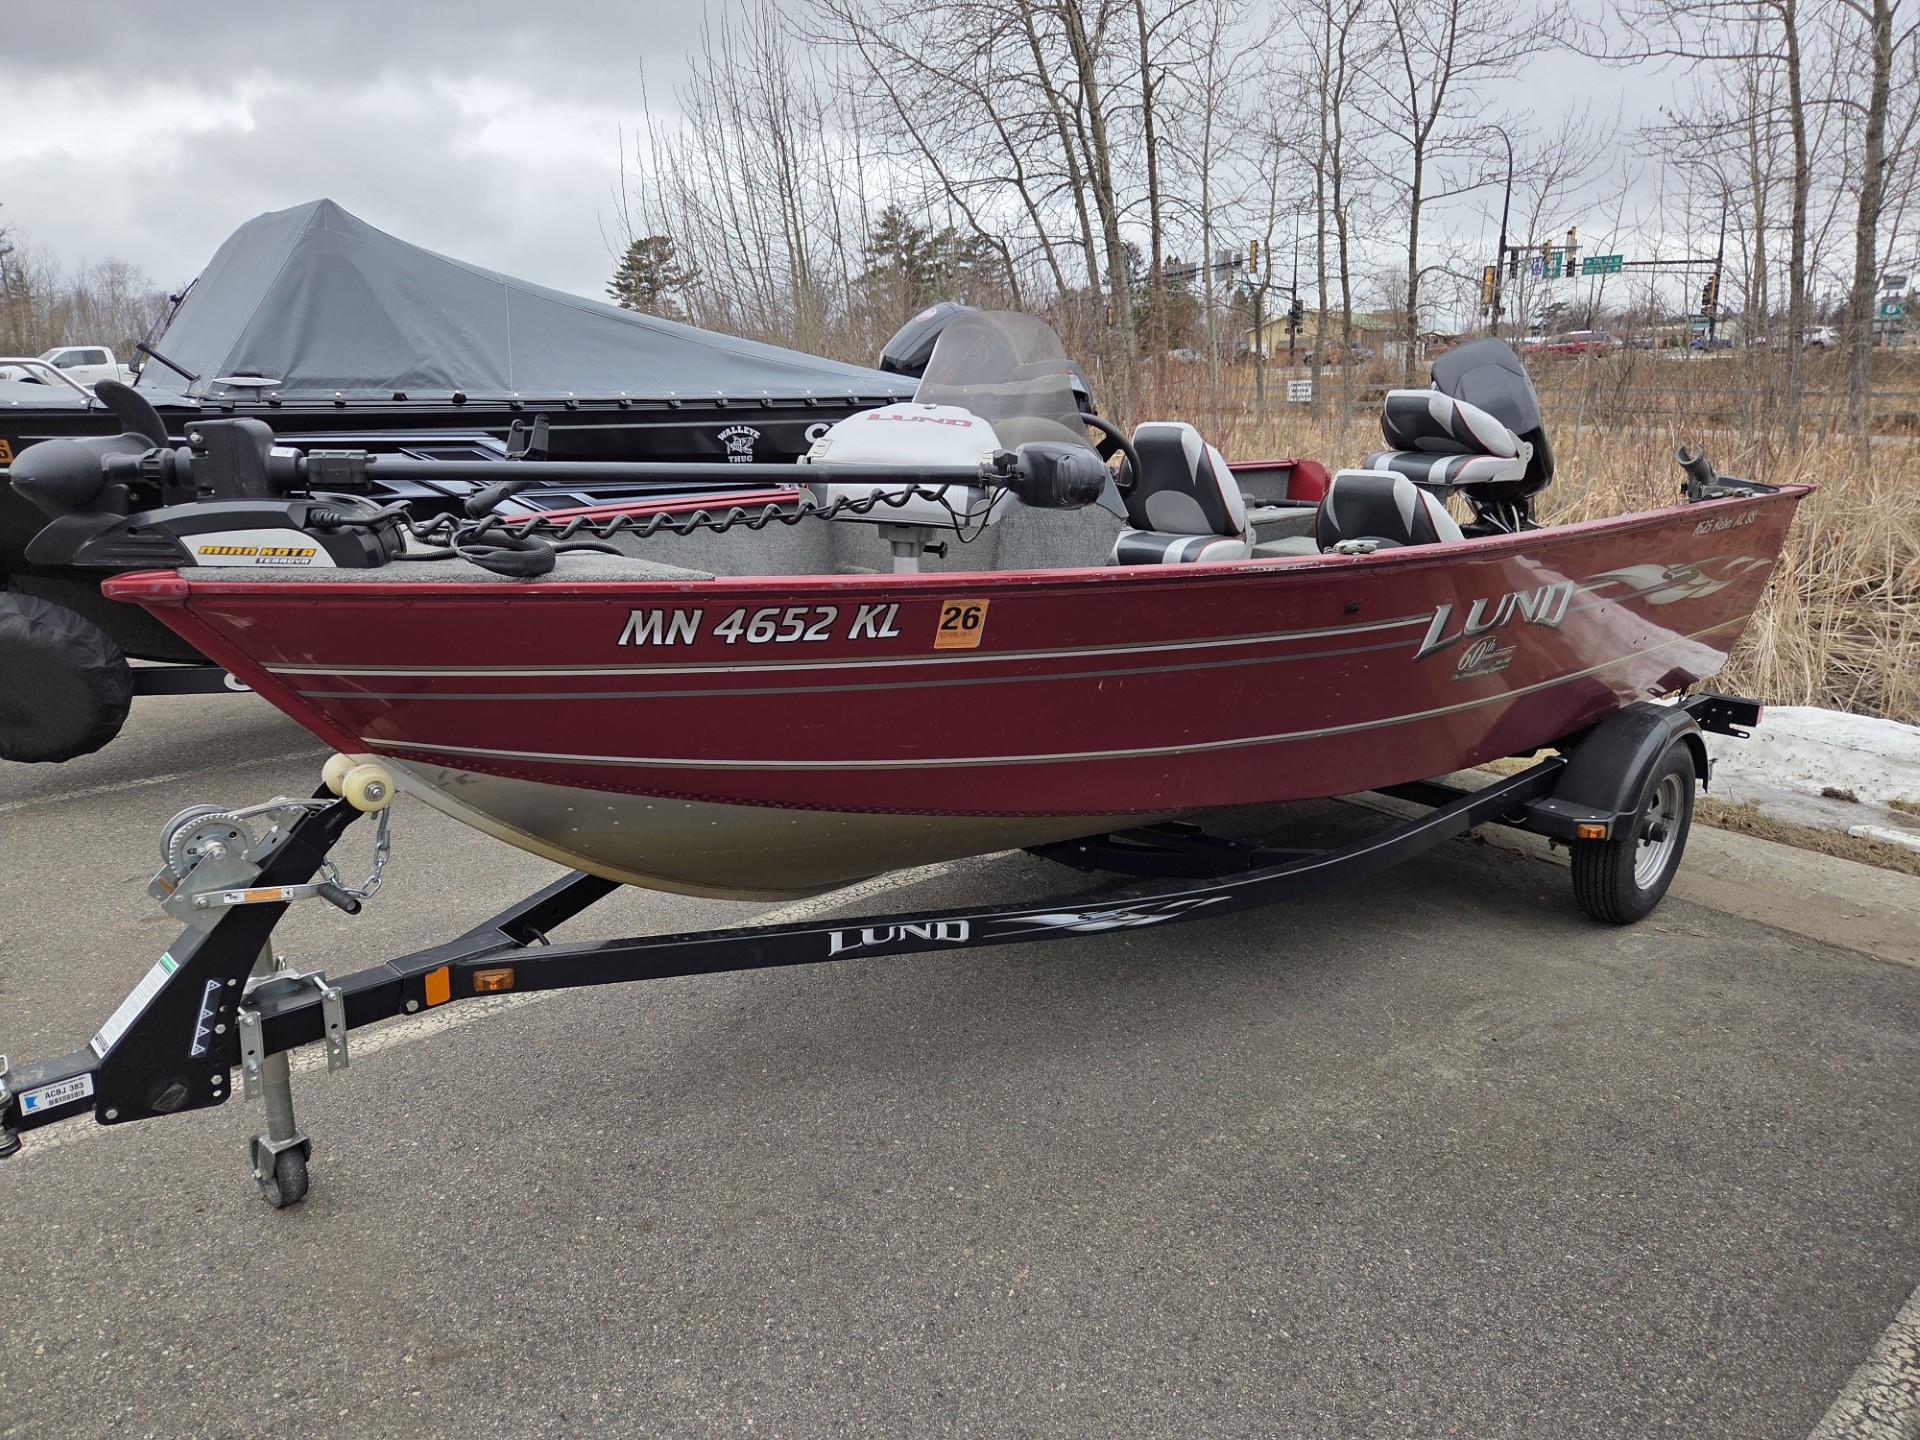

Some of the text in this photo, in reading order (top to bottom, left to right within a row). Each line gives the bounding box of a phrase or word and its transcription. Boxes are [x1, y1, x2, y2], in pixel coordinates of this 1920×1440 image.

[867, 413, 973, 428] LUND
[717, 425, 761, 441] WALLEYE
[728, 455, 753, 463] THUG
[259, 547, 317, 558] KOTA
[617, 603, 901, 646] MN 4652 KL
[940, 606, 982, 631] 26
[1412, 579, 1575, 661] LUND
[827, 920, 970, 957] LUND
[44, 1087, 67, 1100] ACBJ
[69, 1081, 84, 1092] 383
